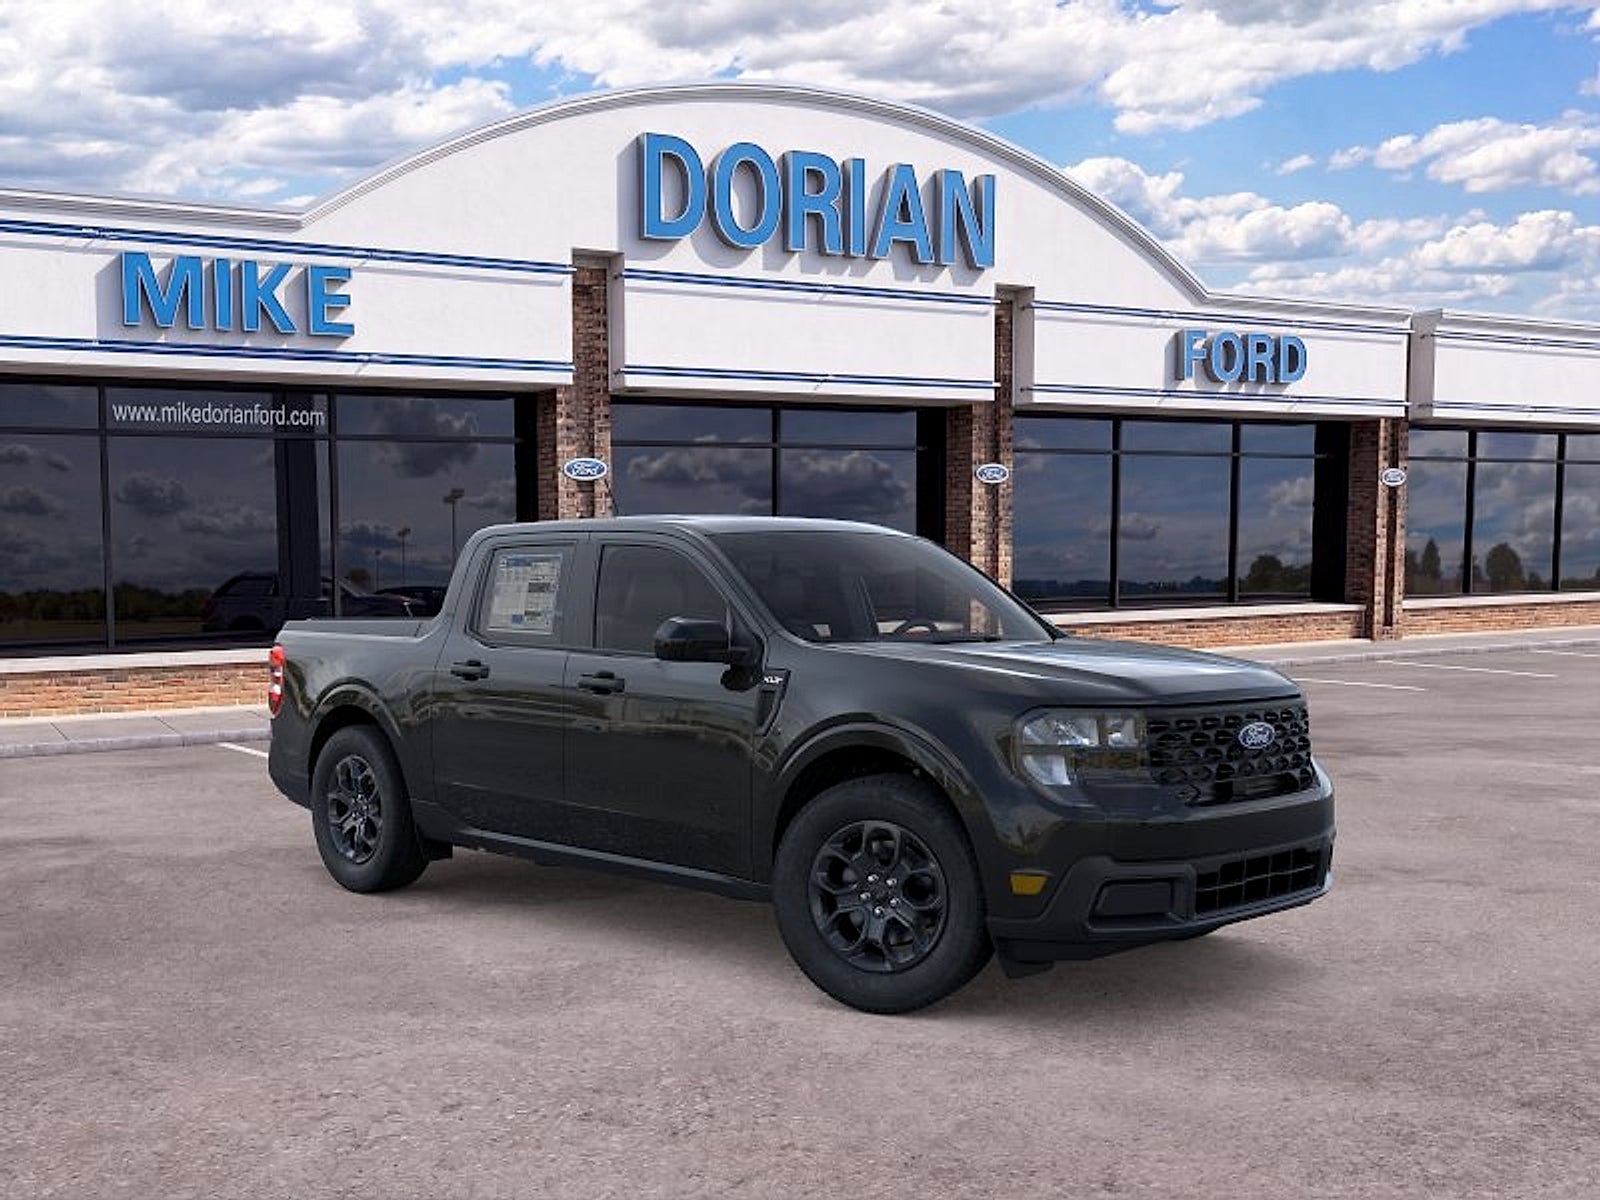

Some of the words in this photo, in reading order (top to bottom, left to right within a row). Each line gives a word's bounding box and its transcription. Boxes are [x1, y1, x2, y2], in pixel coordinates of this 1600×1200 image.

[639, 132, 995, 269] DORIAN
[121, 251, 354, 337] MIKE
[1180, 328, 1307, 383] FORD
[112, 401, 326, 427] www.mikedorianford.com
